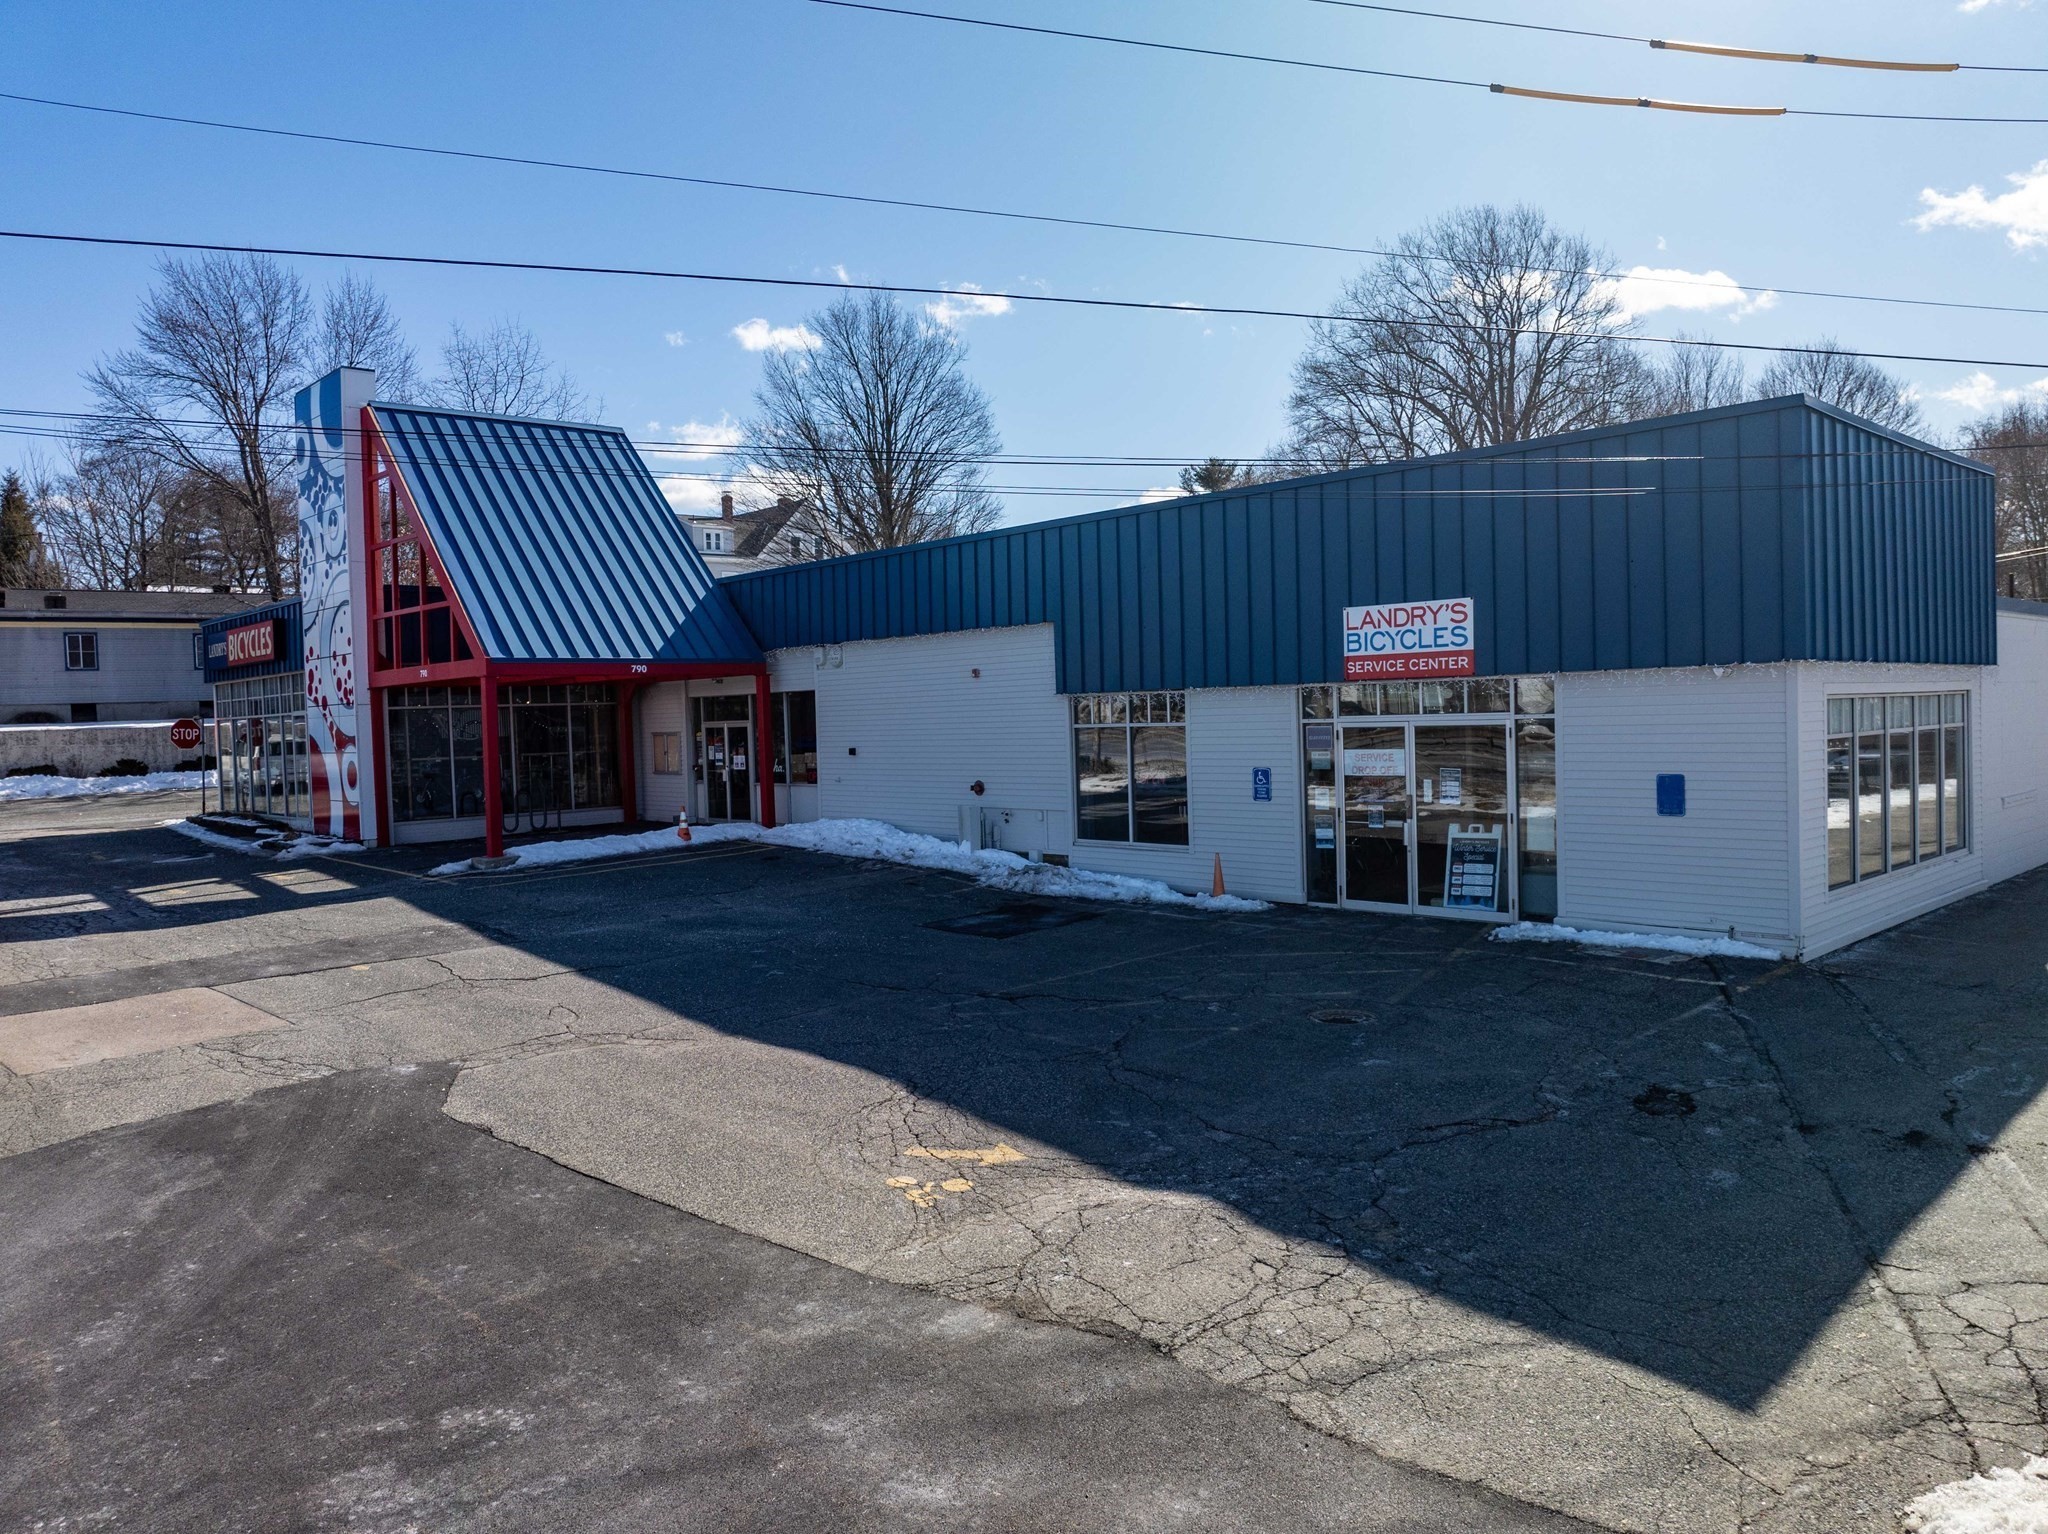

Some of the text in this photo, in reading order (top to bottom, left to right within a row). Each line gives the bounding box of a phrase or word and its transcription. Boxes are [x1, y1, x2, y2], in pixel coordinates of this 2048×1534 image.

[1346, 603, 1469, 631] LANDRY'S
[228, 626, 272, 661] BICYCLES
[1346, 625, 1469, 652] BICYCLES
[631, 665, 647, 673] 790
[1347, 656, 1469, 673] SERVICE CENTER
[172, 728, 199, 740] STOP
[1354, 753, 1394, 763] SERVICE
[1352, 765, 1399, 775] DROP OFF
